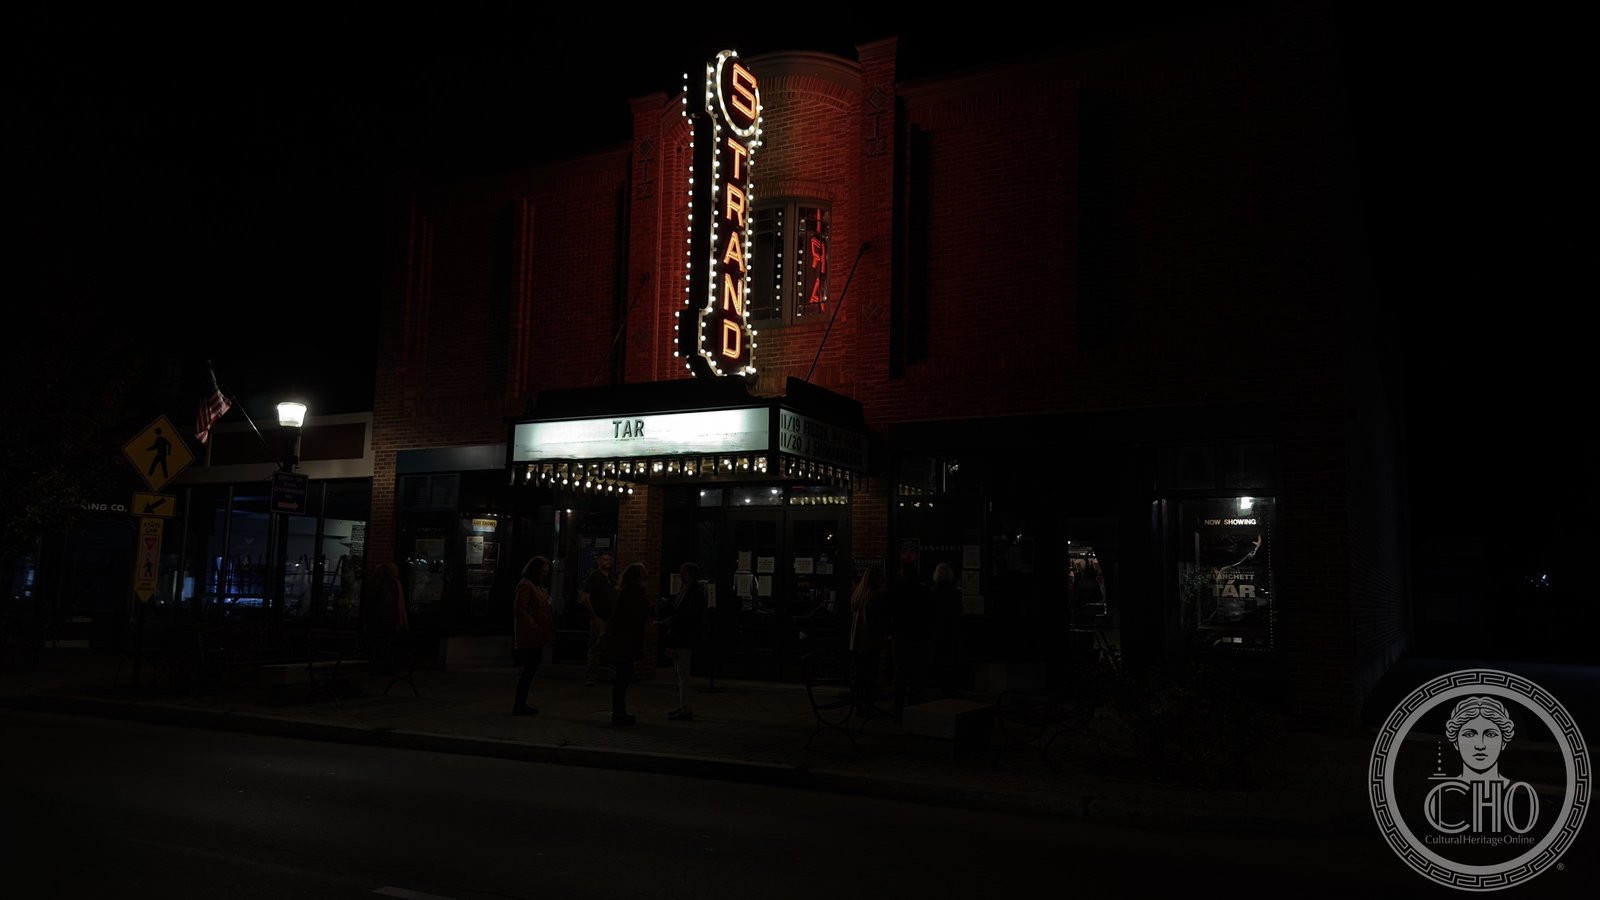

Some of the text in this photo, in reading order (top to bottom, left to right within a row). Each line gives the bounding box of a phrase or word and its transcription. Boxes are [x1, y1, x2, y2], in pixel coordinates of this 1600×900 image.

[721, 62, 758, 360] STRAND
[612, 419, 645, 438] TAR
[780, 413, 801, 433] 11/19
[780, 430, 802, 451] 11/20
[110, 503, 128, 512] CO.
[1223, 518, 1257, 526] SHOWING
[1208, 579, 1256, 598] TÁR
